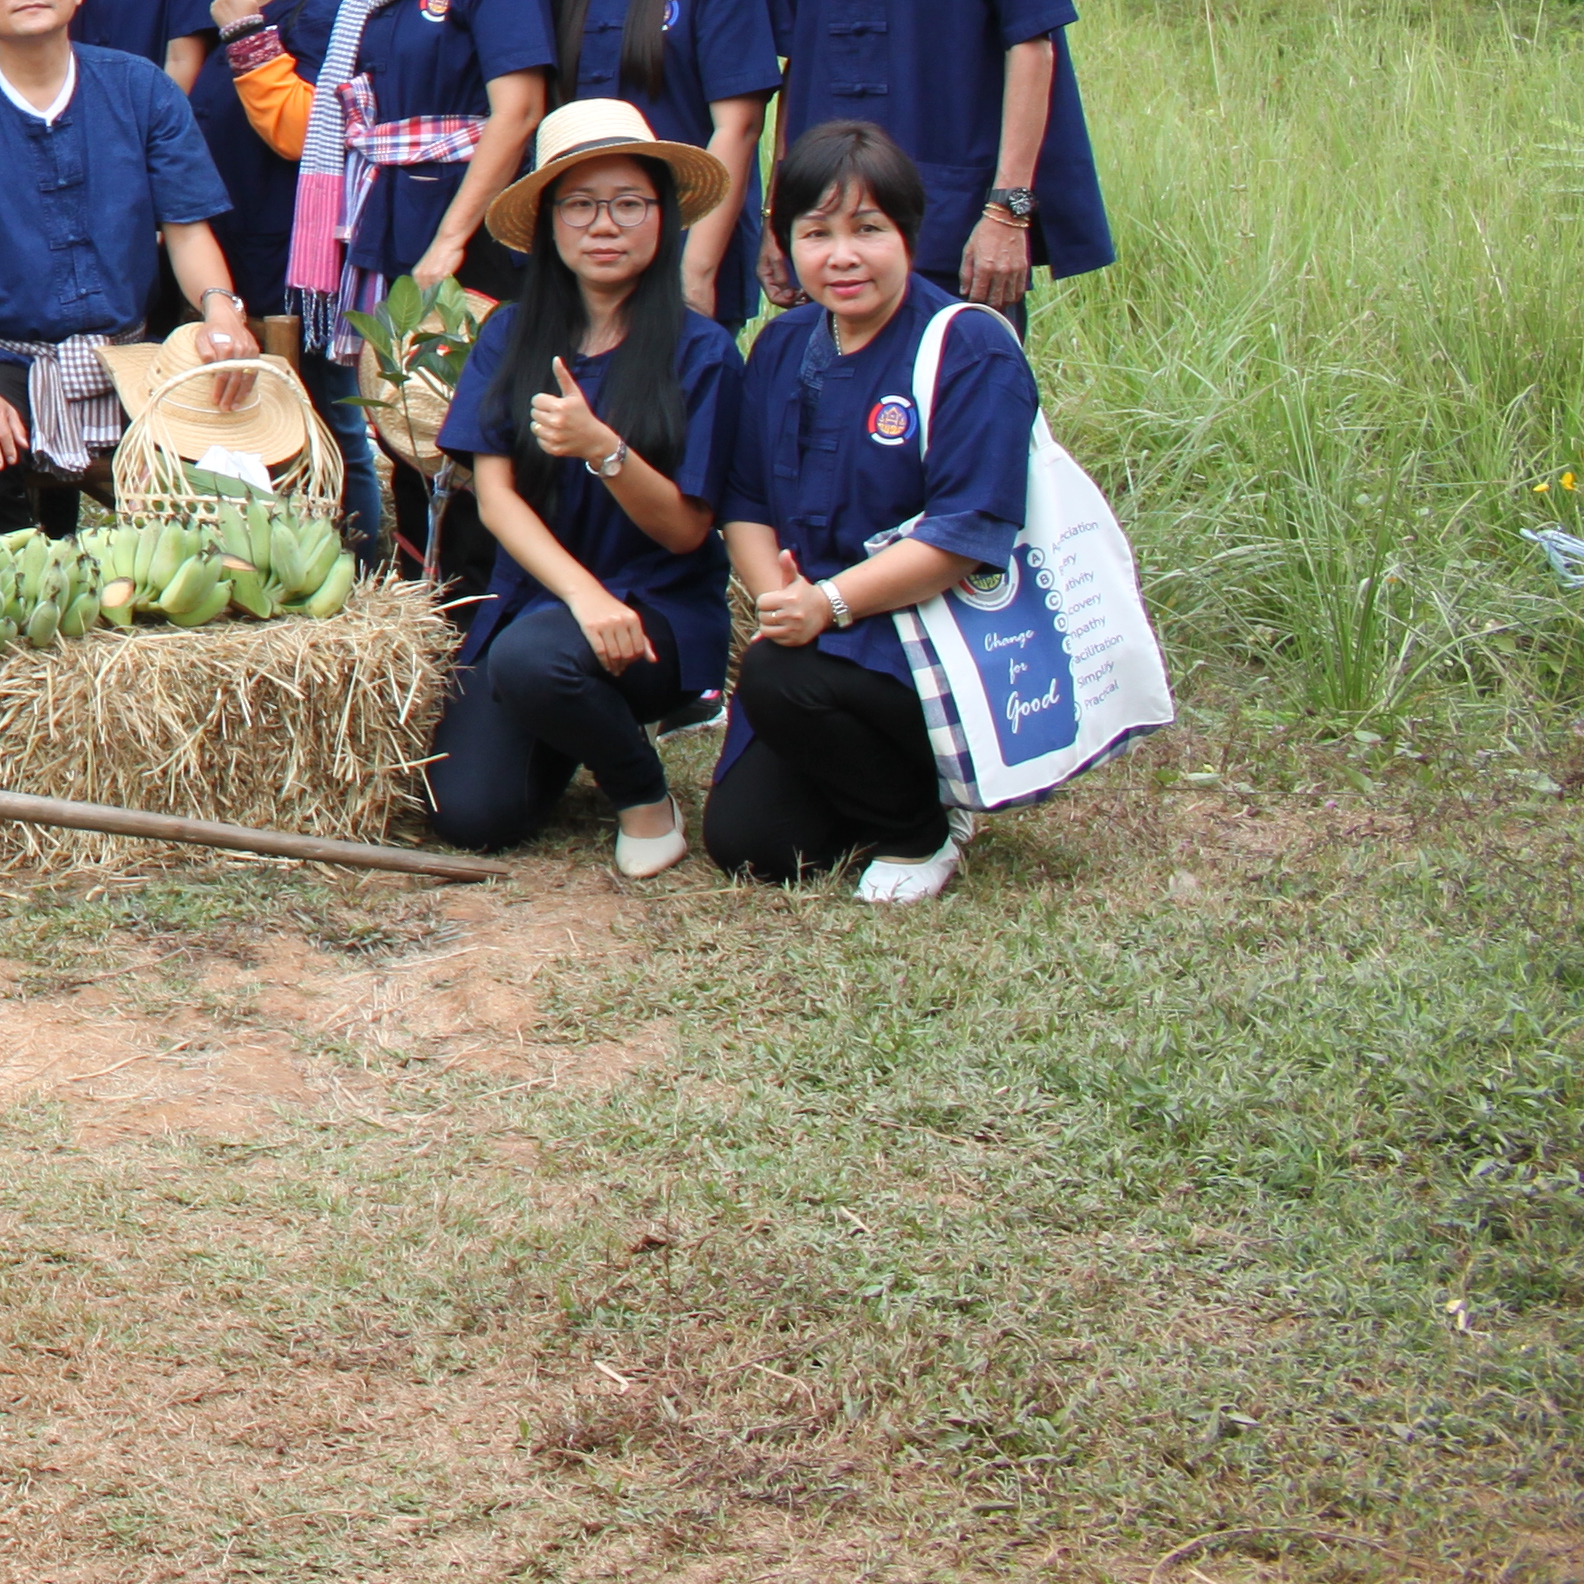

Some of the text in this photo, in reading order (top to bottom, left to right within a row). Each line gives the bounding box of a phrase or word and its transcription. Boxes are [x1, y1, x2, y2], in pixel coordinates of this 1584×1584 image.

[984, 628, 1035, 652] Change
[1009, 658, 1028, 684] for
[1006, 678, 1060, 734] Good
